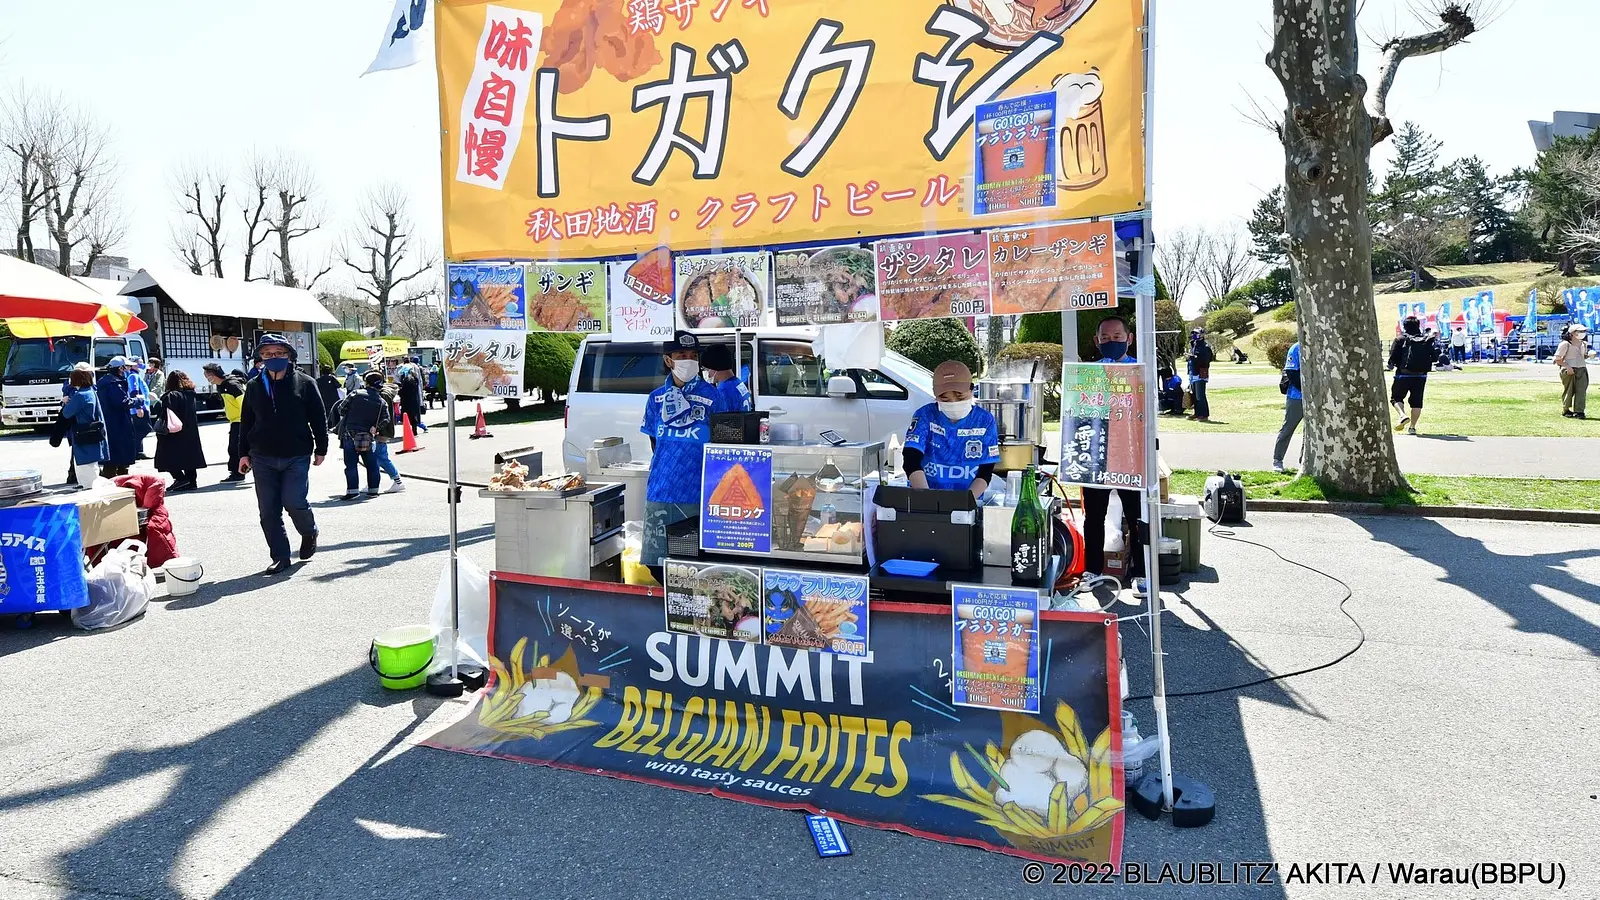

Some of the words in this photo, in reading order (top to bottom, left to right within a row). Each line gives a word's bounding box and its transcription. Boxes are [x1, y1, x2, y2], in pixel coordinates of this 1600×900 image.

[464, 17, 533, 182] 味自慢
[535, 3, 1064, 198] トガクシ
[993, 112, 1035, 130] GO!GO!
[976, 125, 1056, 146] ブラウラガー
[525, 174, 962, 242] 秋田地酒・クラフトビール
[993, 233, 1108, 264] カレーザンギ
[679, 255, 766, 276] 鶏ザンギそば
[879, 246, 986, 279] ザンタレ
[538, 270, 595, 296] ザンギ
[624, 273, 673, 304] 頂コロッケ
[951, 299, 985, 314] 600円
[1070, 292, 1109, 308] 600円
[577, 320, 602, 331] 600円
[624, 318, 651, 331] そば
[650, 325, 673, 336] 600円
[445, 339, 522, 362] ザンタル
[493, 385, 518, 396] 700円
[666, 427, 701, 440] TDK
[758, 450, 772, 458] Top
[937, 463, 979, 480] TDK
[1091, 471, 1142, 487] 1杯500円
[708, 504, 765, 519] 頂コロッケ
[0, 532, 46, 553] ラアイス
[765, 573, 867, 600] ブラウフリッツ
[558, 603, 612, 641] ソースが
[973, 606, 1016, 621] GO!GO!
[560, 623, 599, 653] 選べる
[955, 620, 1038, 637] ブラウラガー
[832, 639, 866, 656] 500円
[645, 632, 875, 706] SUMMIT
[592, 685, 771, 773] BELGIAN
[761, 710, 913, 798] FRITES
[644, 758, 689, 777] with
[691, 766, 738, 787] tasty
[744, 775, 813, 798] sauces
